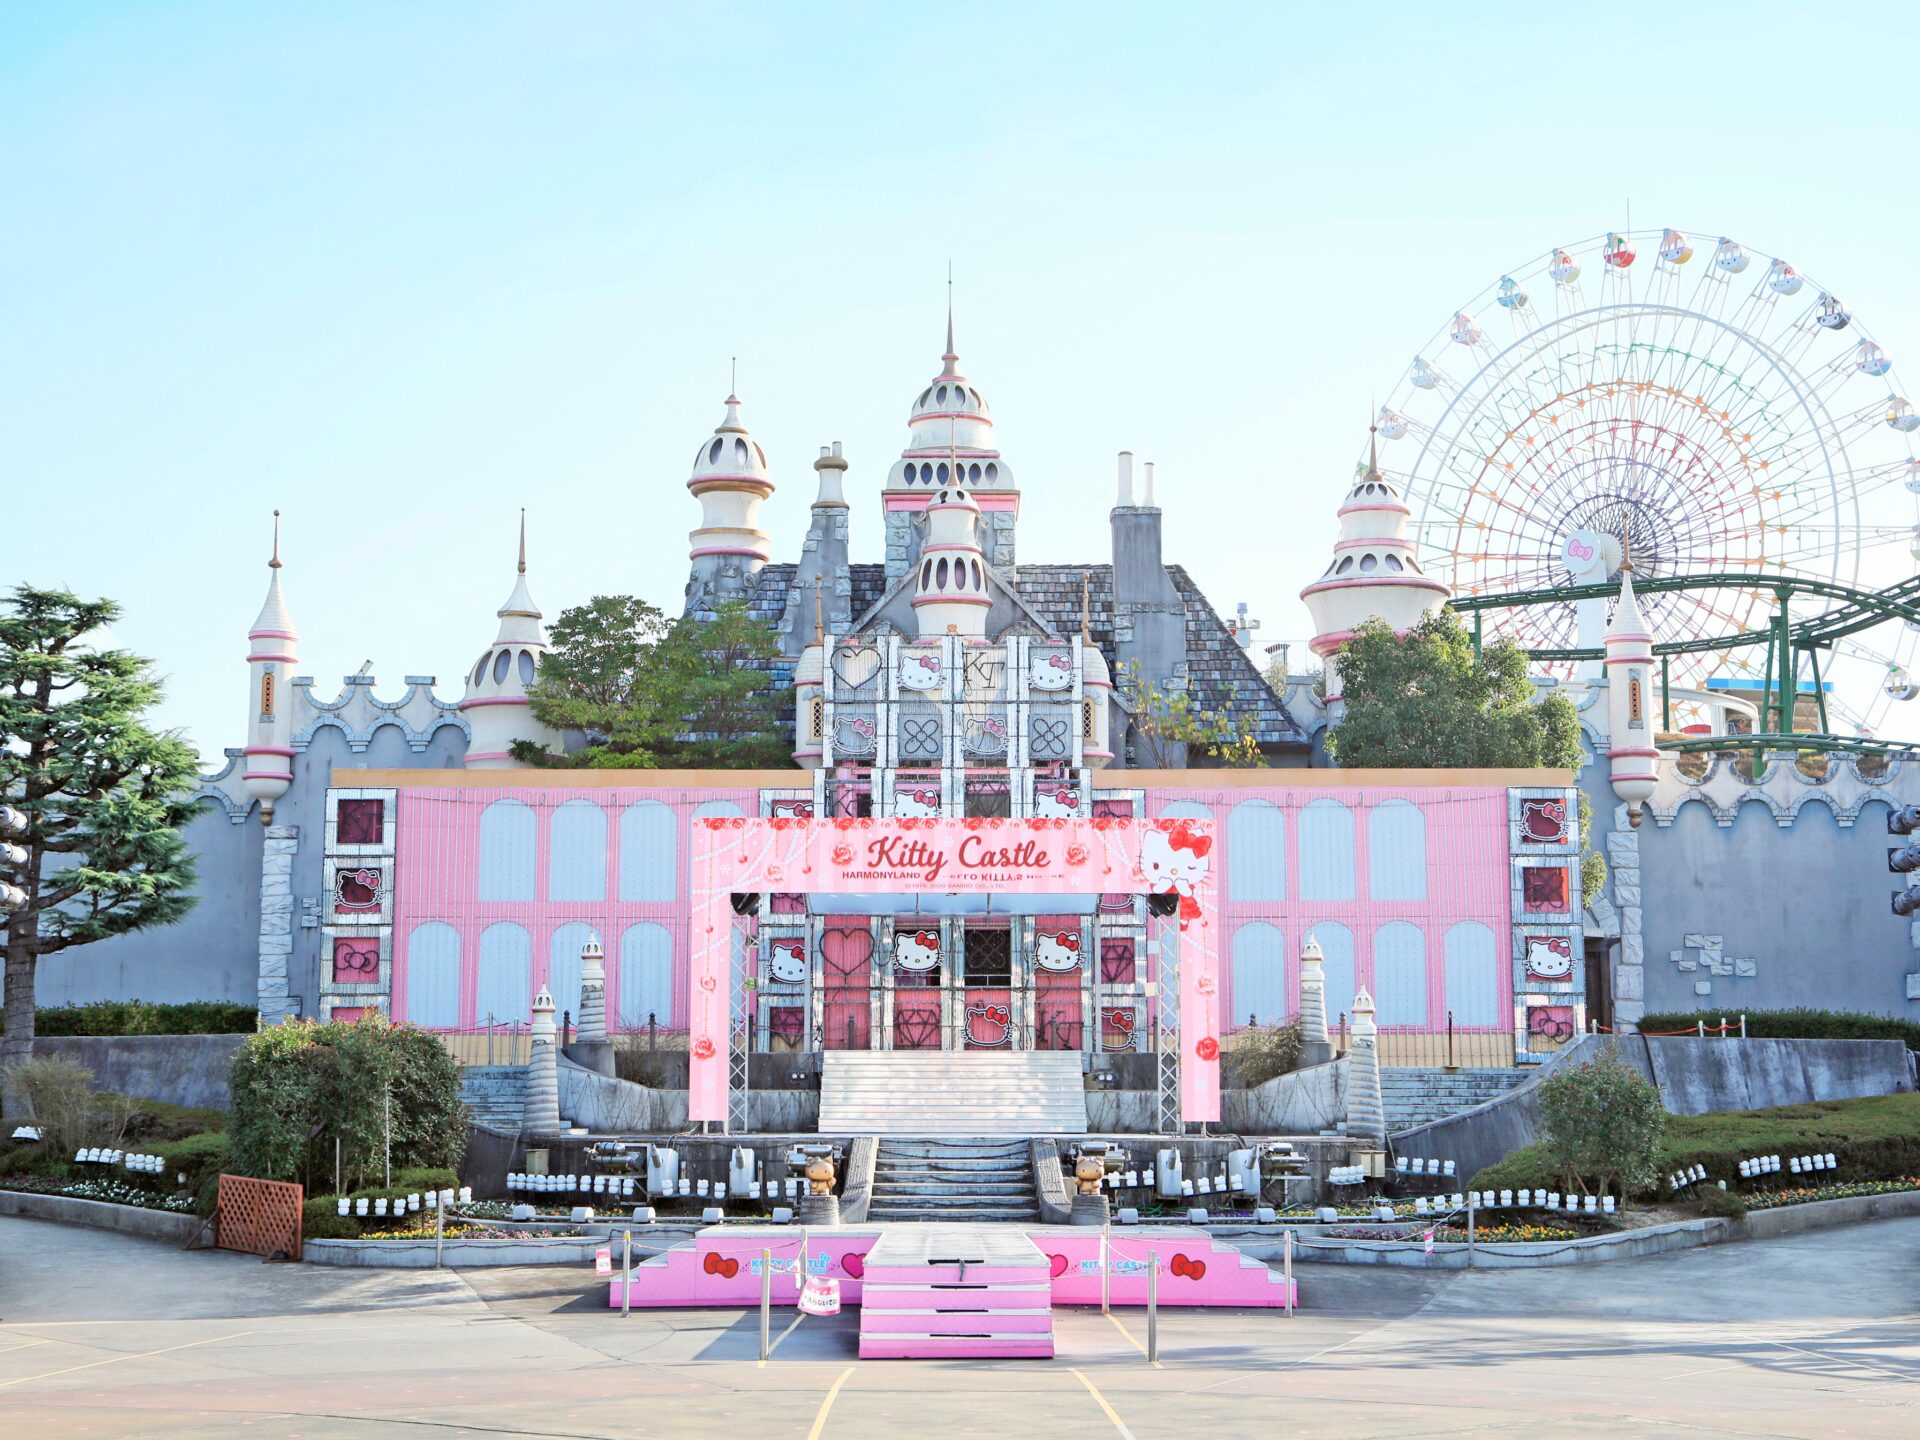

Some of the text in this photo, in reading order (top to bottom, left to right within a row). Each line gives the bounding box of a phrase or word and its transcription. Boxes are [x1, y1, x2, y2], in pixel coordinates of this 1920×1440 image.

[867, 835, 1051, 882] Kitty Castle
[842, 871, 920, 879] HARMONYLAND
